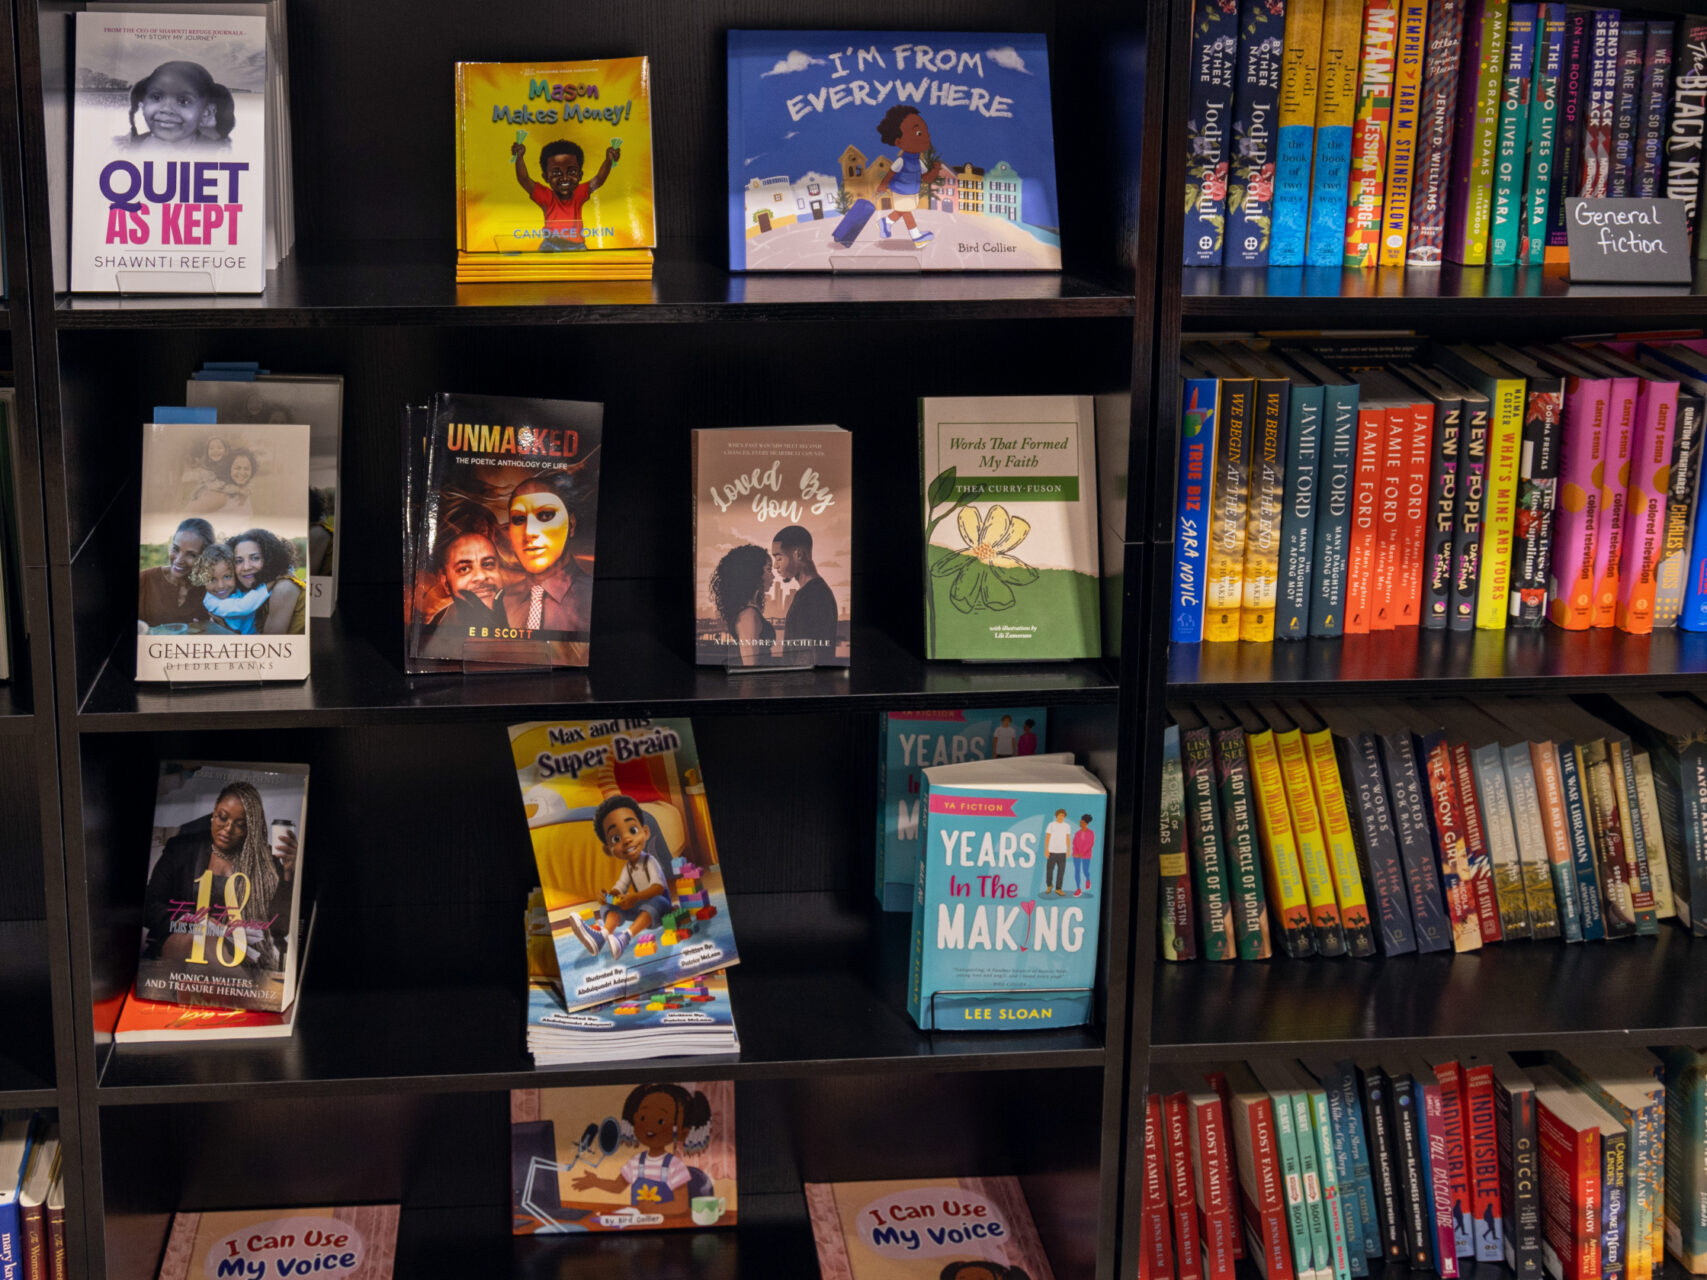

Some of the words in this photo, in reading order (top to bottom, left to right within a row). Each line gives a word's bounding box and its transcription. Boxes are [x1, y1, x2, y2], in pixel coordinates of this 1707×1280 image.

[1403, 7, 1422, 64] MEMPHIS
[828, 46, 886, 79] I'M
[892, 44, 984, 79] FROM
[1362, 8, 1395, 98] MAAME
[1509, 44, 1523, 70] THE
[528, 78, 599, 102] Mason
[785, 77, 1015, 122] EVERYWHERE
[1506, 76, 1520, 111] TWO
[492, 105, 558, 124] Makes
[563, 100, 632, 126] Money!
[1502, 117, 1516, 156] LIVES
[99, 160, 249, 213] QUIET
[1500, 163, 1512, 182] OF
[1495, 187, 1510, 225] SARA
[1575, 201, 1661, 225] General
[105, 203, 150, 245] AS
[161, 203, 243, 245] KEPT
[513, 228, 577, 239] CANDACE
[580, 227, 614, 237] OKIN
[958, 243, 980, 253] Bird
[983, 242, 1017, 253] Collier
[1598, 227, 1668, 254] fiction
[94, 256, 173, 268] SHAWNTI
[180, 256, 247, 269] REFUGE
[1231, 393, 1244, 416] WE
[447, 423, 579, 458] UNMASKED
[950, 437, 987, 451] Words
[990, 437, 1018, 451] That
[1020, 437, 1069, 450] Formed
[1229, 419, 1243, 463] BEGIN
[1299, 403, 1317, 460] JAMIE
[456, 457, 469, 465] THE
[498, 459, 541, 469] ANTHOLOGY
[979, 455, 1001, 471] My
[1005, 455, 1039, 468] Faith
[1227, 465, 1240, 484] AT
[710, 460, 782, 513] Loved
[800, 468, 835, 515] By
[956, 484, 985, 493] THEA
[988, 484, 1062, 493] CURRY-FUSON
[1226, 484, 1239, 516] THE
[1295, 466, 1313, 518] FORD
[752, 493, 803, 523] You
[1224, 519, 1237, 549] END
[469, 627, 476, 636] E
[481, 628, 488, 637] B
[494, 629, 532, 639] SCOTT
[148, 642, 293, 659] GENERATIONS
[548, 725, 586, 748] Max
[589, 720, 620, 741] and
[537, 748, 608, 780] Super
[615, 729, 680, 763] Brain
[1431, 746, 1445, 777] THE
[1196, 768, 1210, 796] LADY
[944, 802, 956, 810] YA
[960, 801, 1003, 812] FICTION
[1199, 800, 1214, 832] TAN'S
[1435, 782, 1454, 827] SHOW
[940, 829, 1037, 868] YEARS
[1203, 836, 1219, 873] CIRCLE
[1444, 831, 1458, 866] GIRL
[949, 874, 970, 898] In
[976, 875, 1018, 899] The
[1207, 876, 1220, 889] OF
[185, 869, 251, 968] 18
[1208, 893, 1224, 933] WOMEN
[145, 979, 166, 988] AND
[169, 981, 214, 994] TREASURE
[217, 986, 277, 999] HERNANDEZ
[170, 972, 209, 982] MONICA
[211, 976, 253, 988] WALTERS
[964, 1008, 992, 1020] LEE
[999, 1008, 1052, 1019] SLOAN
[1205, 1124, 1217, 1156] LOST
[1471, 1094, 1498, 1199] INDIVISIBLE
[1208, 1159, 1222, 1206] FAMILY
[1517, 1138, 1532, 1199] GUCCI
[870, 1208, 887, 1226] I
[890, 1203, 934, 1224] Can
[942, 1200, 987, 1219] Use
[871, 1223, 919, 1251] My
[932, 1220, 1004, 1245] Voice
